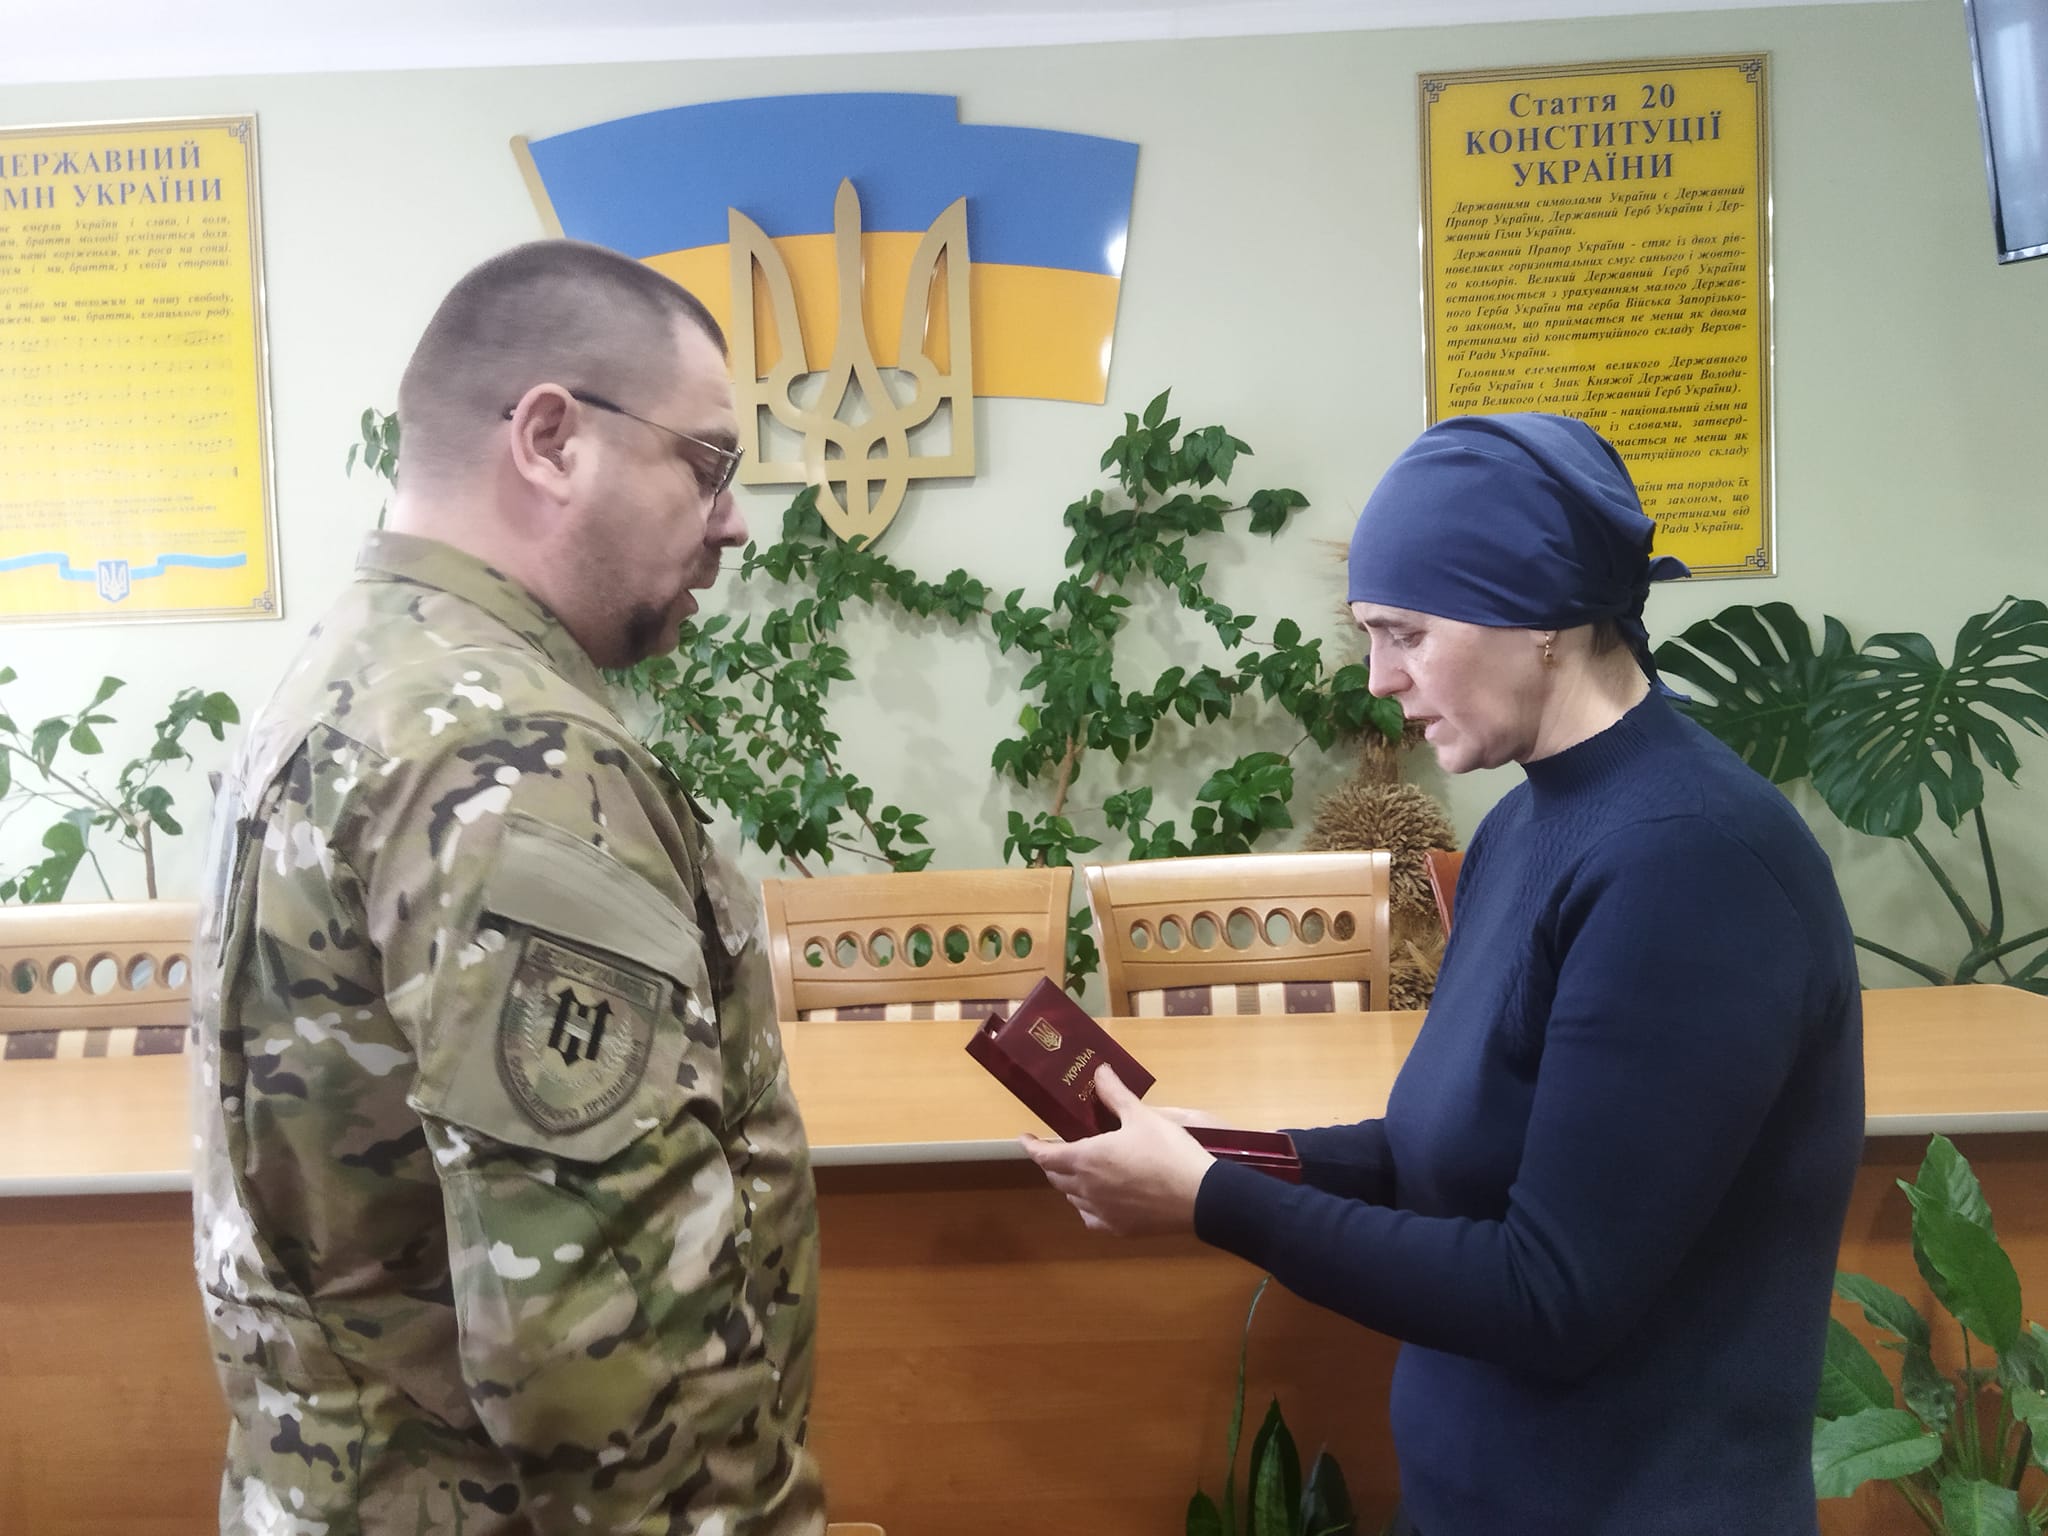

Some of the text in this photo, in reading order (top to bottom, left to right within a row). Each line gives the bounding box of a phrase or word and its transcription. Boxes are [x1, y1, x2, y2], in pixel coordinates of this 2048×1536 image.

[1508, 83, 1675, 117] Стаття 20
[1465, 110, 1722, 156] КОНСТИТУЦІЇ
[1511, 151, 1673, 187] УКРАЇНИ
[3, 175, 221, 209] МН УКРАЇНИ
[1450, 200, 1530, 214] Державними
[1535, 195, 1602, 208] символами
[1608, 190, 1657, 205] України
[1673, 186, 1745, 200] Державний
[1444, 216, 1489, 230] Прапор
[1547, 206, 1618, 223] Державний
[1623, 204, 1651, 218] Герб
[1655, 201, 1704, 216] України
[1715, 199, 1745, 213] Дер-
[1444, 229, 1491, 242] жавний
[1493, 228, 1522, 239] Гімн
[1451, 245, 1522, 261] Державний
[1527, 243, 1572, 257] Прапор
[1576, 239, 1625, 254] України
[1640, 239, 1672, 248] стяг
[1675, 235, 1686, 246] із
[1690, 234, 1716, 245] двох
[1721, 234, 1745, 246] рів-
[1444, 263, 1504, 274] новеликих
[1507, 258, 1602, 272] горизонтальних
[1606, 255, 1636, 267] смуг
[1638, 253, 1685, 263] синього
[1696, 249, 1745, 259] жовто-
[1444, 281, 1458, 289] го
[1526, 271, 1576, 285] Великий
[1582, 269, 1654, 282] Державний
[1661, 264, 1690, 278] Герб
[1697, 261, 1746, 276] України
[1445, 290, 1546, 303] встановлюється
[1560, 284, 1639, 299] урахуванням
[1643, 282, 1687, 292] малого
[1690, 278, 1746, 291] Держав-
[1445, 292, 1746, 319] ного Герба України та герба Війська Запорізько-
[1445, 325, 1458, 333] го
[1521, 320, 1539, 329] що
[1544, 315, 1625, 329] приймається
[1629, 313, 1645, 322] не
[1649, 311, 1684, 321] менш
[1688, 310, 1704, 319] як
[1709, 307, 1747, 317] двома
[1446, 322, 1747, 349] третинами від конституційного складу Верхов-
[1446, 349, 1466, 361] ної
[1467, 349, 1497, 361] Ради
[1456, 354, 1748, 378] Головним елементом великого Державного
[1448, 381, 1481, 395] Герба
[1486, 379, 1534, 393] України
[1552, 377, 1579, 388] Знак
[1585, 373, 1634, 386] Княжої
[1636, 371, 1694, 385] Держави
[1699, 368, 1747, 380] Володи-
[1447, 399, 1478, 409] мира
[1481, 395, 1534, 406] Великого
[1536, 393, 1579, 404] (малий
[1580, 387, 1651, 403] Державний
[1653, 385, 1682, 399] Герб
[1619, 401, 1700, 417] національний
[1702, 400, 1730, 412] гімн
[1732, 401, 1748, 410] на
[1608, 420, 1619, 431] із
[1692, 413, 1748, 427] затверд-
[1672, 435, 1687, 444] не
[1693, 433, 1727, 443] менш
[1733, 432, 1748, 440] як
[1620, 444, 1749, 462] титуційного складу
[1665, 482, 1684, 490] та
[1686, 478, 1734, 491] порядок
[1737, 476, 1750, 487] їх
[1731, 493, 1750, 502] що
[1655, 509, 1727, 523] третинами
[1731, 505, 1750, 516] від
[1659, 523, 1690, 534] Ради
[1062, 1047, 1096, 1086] УКРАЇНА
